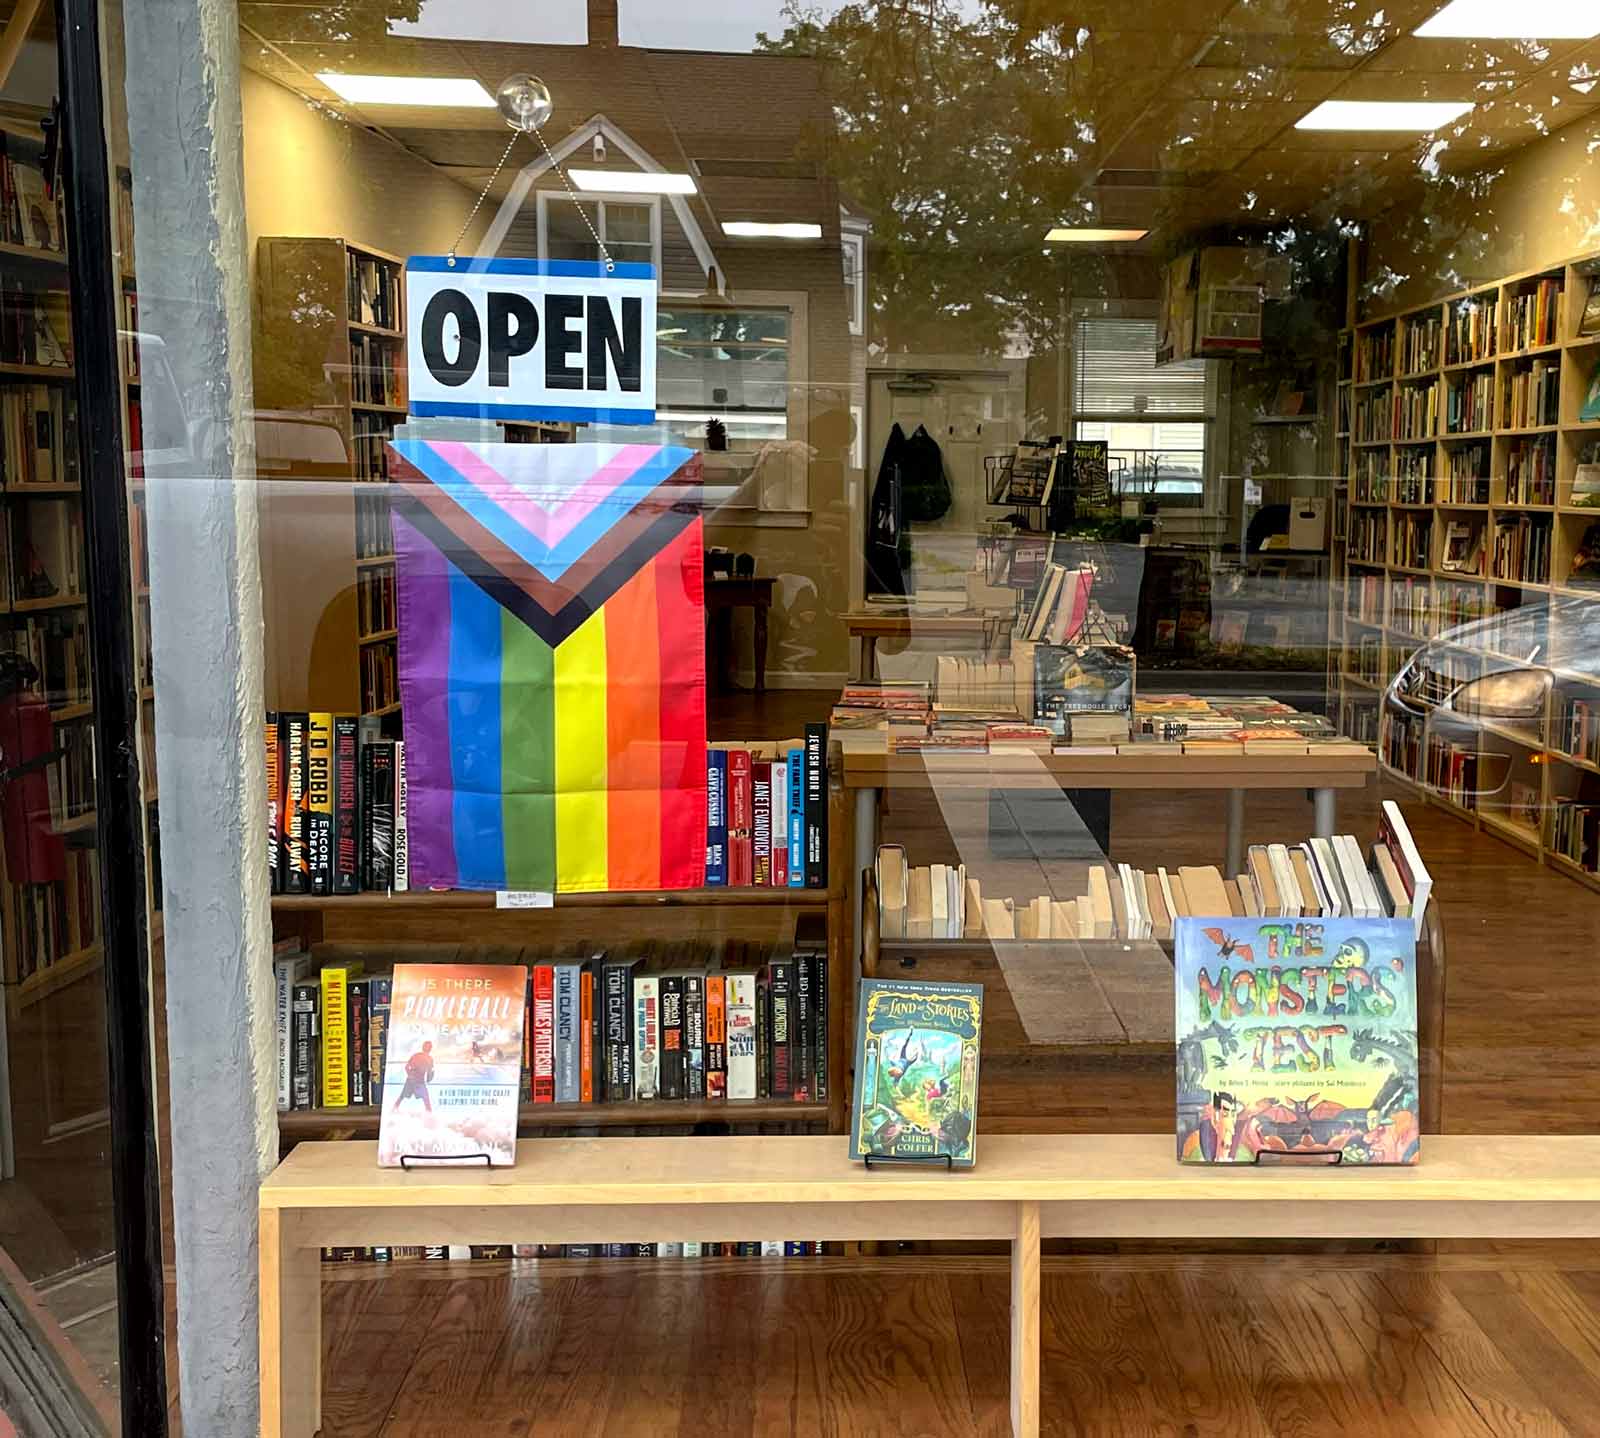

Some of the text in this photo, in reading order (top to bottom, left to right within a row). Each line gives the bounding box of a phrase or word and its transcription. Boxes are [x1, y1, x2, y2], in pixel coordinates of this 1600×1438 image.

[421, 288, 642, 392] OPEN
[290, 723, 302, 801] HARLAN COBEN
[340, 736, 354, 756] IRIS
[808, 734, 820, 766] JEWISH
[310, 758, 328, 804] ROBB
[340, 760, 354, 809] JOHANSEN
[708, 768, 719, 826] CLIVE CUSSLER
[754, 780, 769, 807] JANET
[808, 770, 820, 790] NOIR
[290, 816, 302, 872] RUN AWAY
[310, 819, 318, 870] IN DEATH
[320, 820, 329, 869] ENCORE
[754, 809, 769, 856] EVANOVICH
[340, 838, 354, 875] BULLET
[396, 828, 406, 875] ROSE GOLD
[713, 844, 722, 866] BLACK
[1258, 923, 1325, 959] THE
[424, 978, 493, 990] IS THERE
[560, 970, 570, 994] TOM
[328, 982, 342, 1028] MICHAEL
[404, 996, 511, 1019] PICKLEBALL
[560, 996, 570, 1042] CLANCY
[608, 970, 620, 1042] TOM CLANCY
[663, 992, 671, 1026] Cornwell
[671, 992, 680, 1018] Patricia
[774, 996, 787, 1042] JAMES PATTERSON
[798, 992, 808, 1020] James
[888, 998, 917, 1019] LAND
[922, 1002, 970, 1026] STORIES
[298, 1014, 307, 1040] MICHAEL
[536, 999, 552, 1077] JAMES PATTERSON
[686, 1004, 694, 1045] ULTIMATUM
[694, 1012, 702, 1048] BOURNE
[298, 1042, 307, 1072] CONNELLY
[328, 1038, 342, 1090] CRICHTON
[1243, 1024, 1349, 1074] TEST
[896, 1143, 934, 1152] COLFER
[901, 1135, 930, 1144] CHRIS
